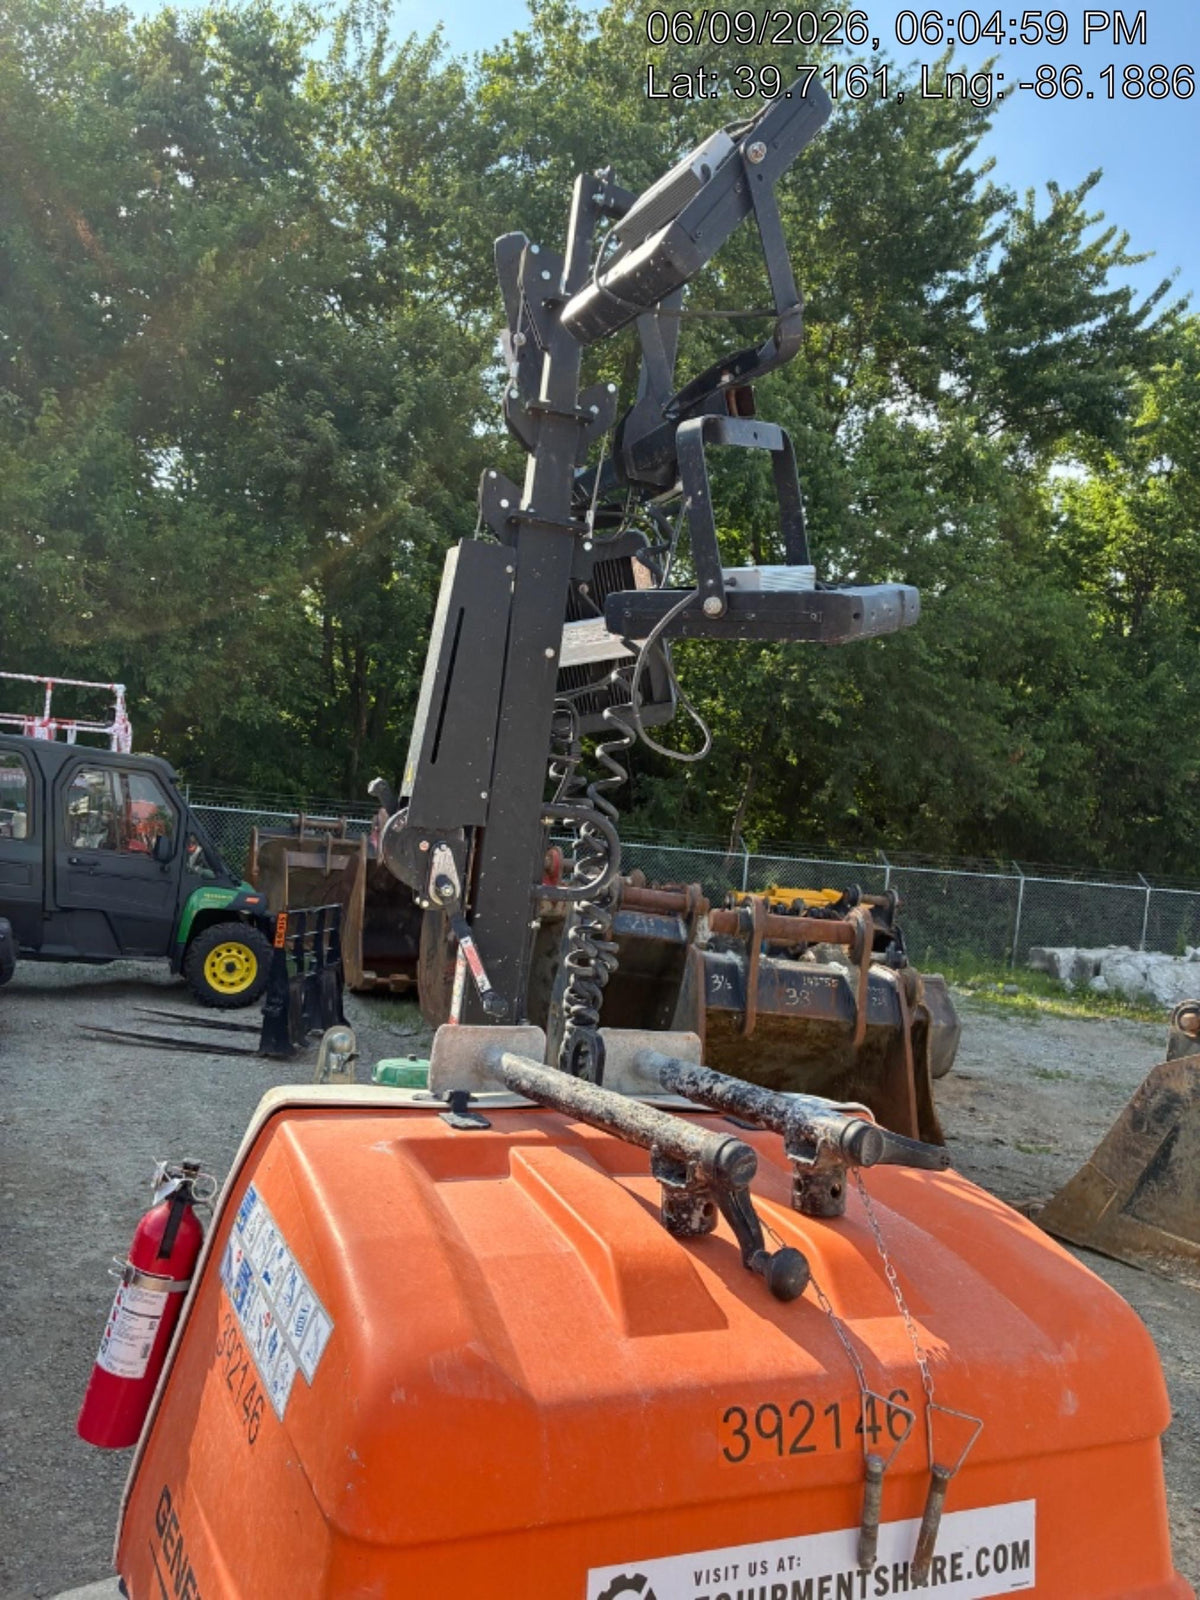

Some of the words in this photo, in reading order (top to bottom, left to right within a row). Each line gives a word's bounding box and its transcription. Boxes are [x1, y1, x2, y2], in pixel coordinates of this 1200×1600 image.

[217, 1314, 266, 1446] 392146
[722, 1389, 911, 1463] 392146
[156, 1484, 202, 1600] GENE
[694, 1564, 740, 1586] VISIT
[748, 1560, 768, 1577] US
[776, 1555, 801, 1573] AT:
